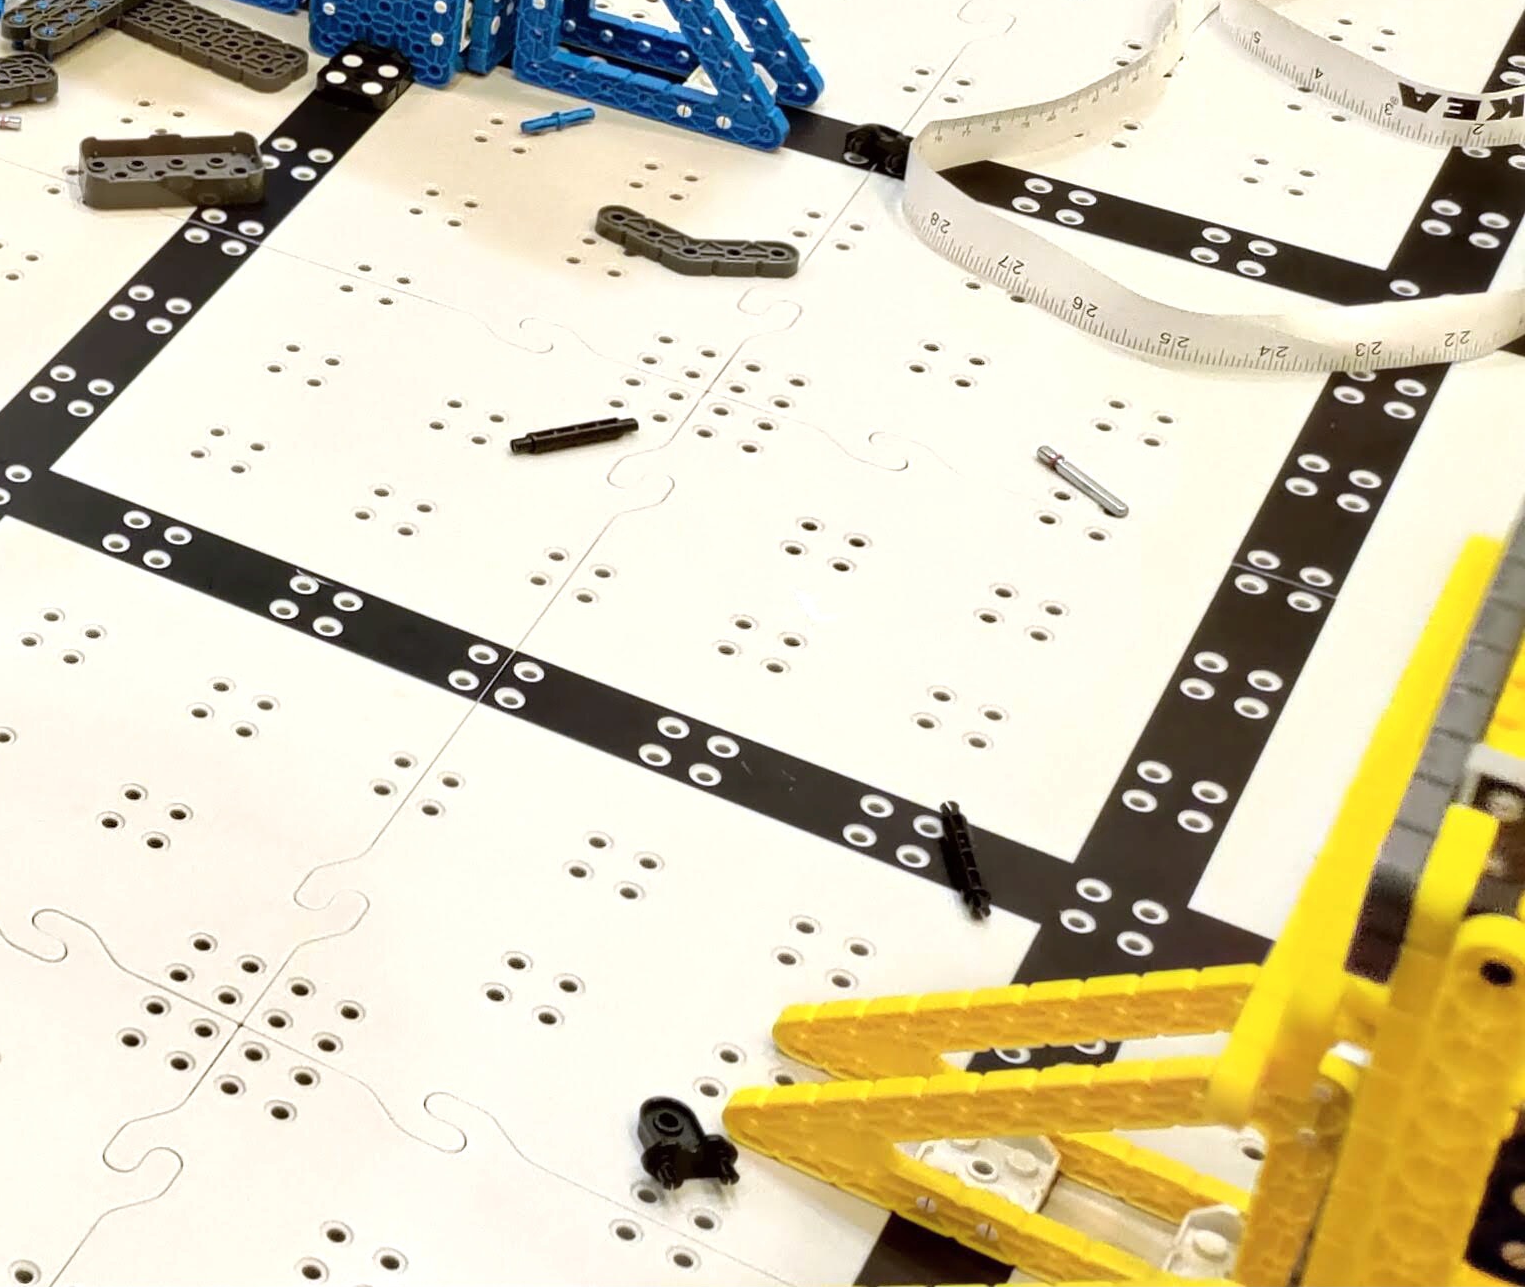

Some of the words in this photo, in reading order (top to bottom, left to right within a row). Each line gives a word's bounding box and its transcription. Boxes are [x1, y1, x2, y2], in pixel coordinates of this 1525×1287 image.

[1253, 30, 1262, 44] 5
[1313, 66, 1324, 80] 4
[1384, 102, 1394, 116] 3
[1397, 81, 1525, 121] KEA
[1472, 122, 1485, 136] 2
[929, 211, 951, 234] 28
[997, 254, 1025, 275] 27
[1071, 296, 1099, 318] 26
[1159, 331, 1190, 349] 25
[1443, 329, 1471, 347] 22
[1258, 345, 1290, 359] 24
[1354, 340, 1383, 357] 23
